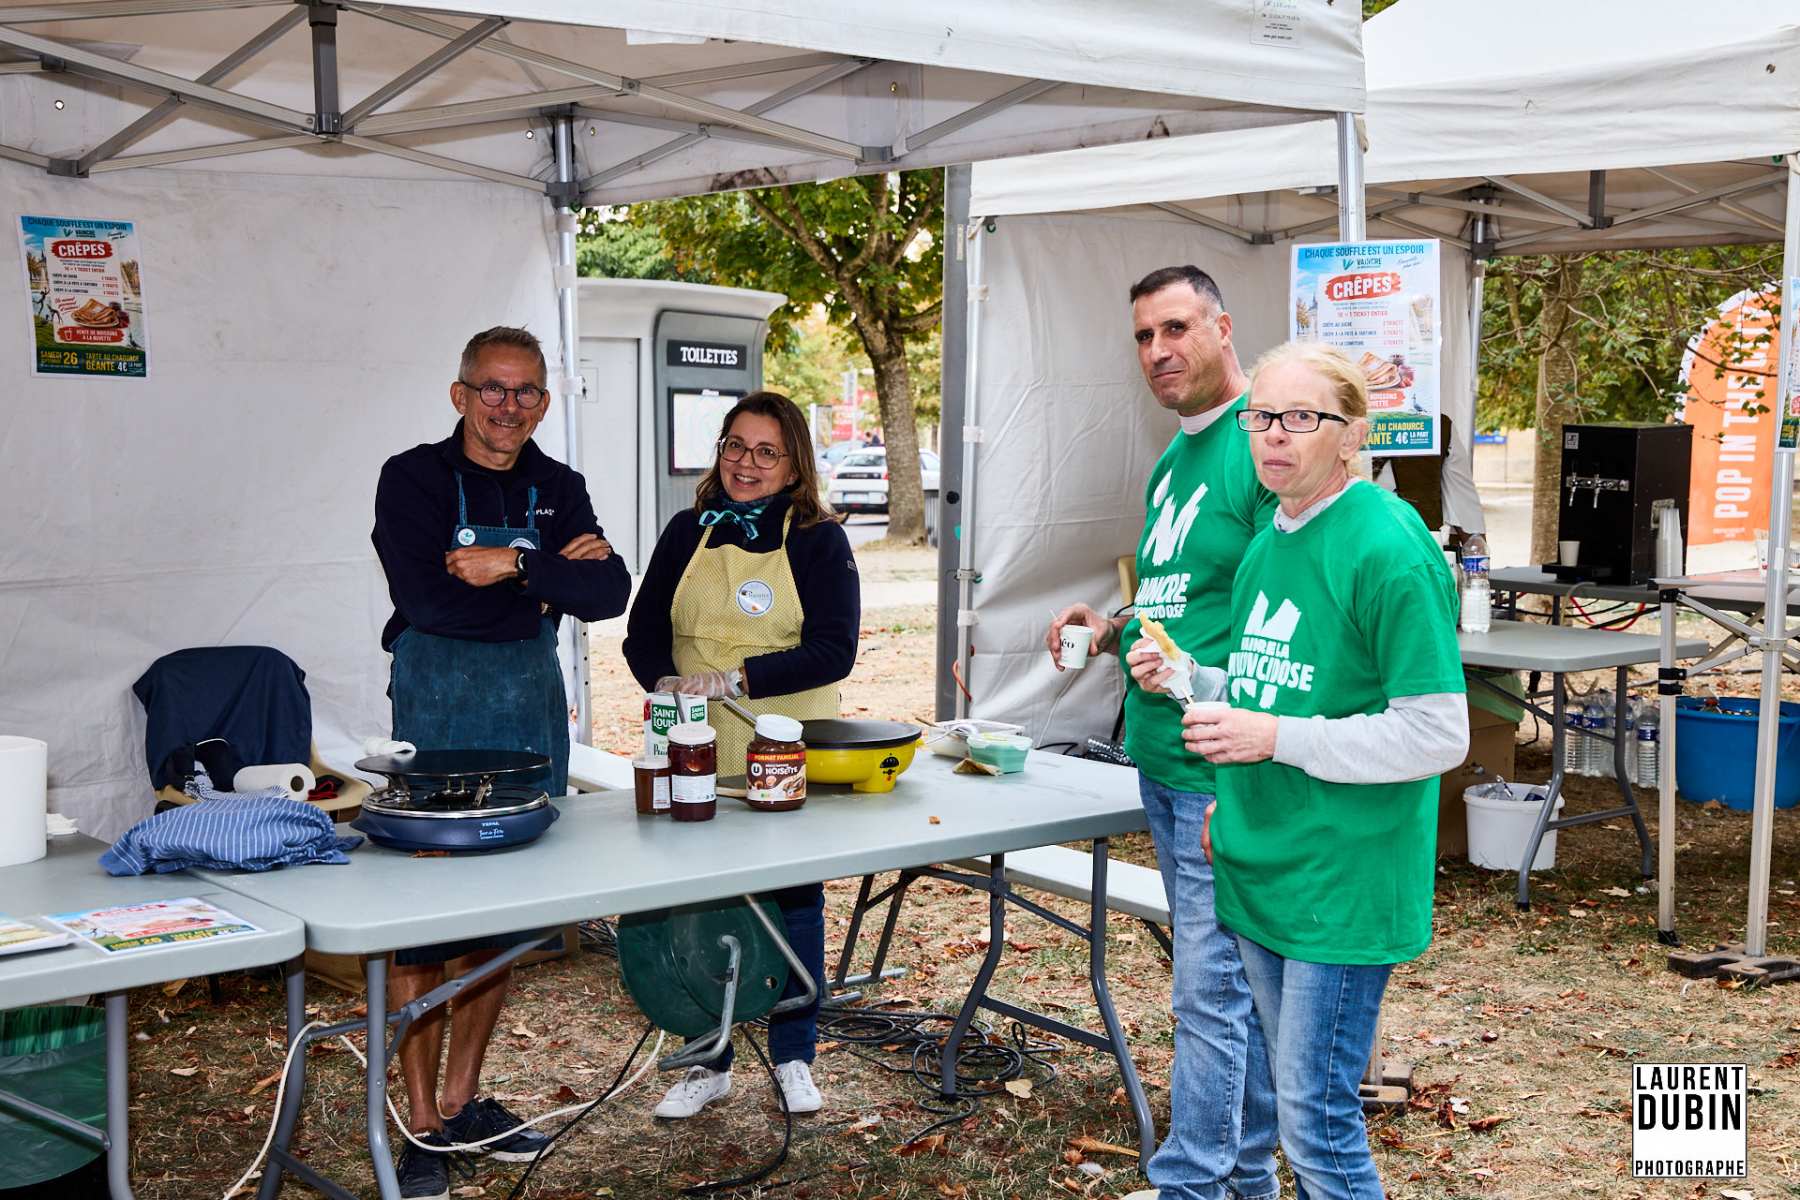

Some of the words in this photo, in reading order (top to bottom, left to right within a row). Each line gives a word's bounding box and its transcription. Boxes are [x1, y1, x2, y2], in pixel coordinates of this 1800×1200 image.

[58, 242, 106, 257] CRÊPES
[1305, 247, 1334, 259] CHAQUE
[1335, 246, 1367, 257] SOUFFLE
[1368, 245, 1380, 255] EST
[1383, 245, 1393, 255] UN
[1395, 244, 1424, 254] ESPOIR
[1333, 276, 1392, 299] CRÊPES
[63, 352, 78, 366] 26
[680, 347, 738, 365] TOILETTES
[117, 362, 128, 372] 4€
[1723, 375, 1764, 428] THE
[1368, 432, 1392, 445] ANTE
[1395, 431, 1409, 445] 4€
[1718, 435, 1757, 462] IN
[1713, 468, 1753, 519] POP
[1276, 642, 1290, 659] LA
[653, 707, 676, 719] SAINT
[653, 717, 677, 729] LOUIS
[765, 766, 798, 775] NOISETTE
